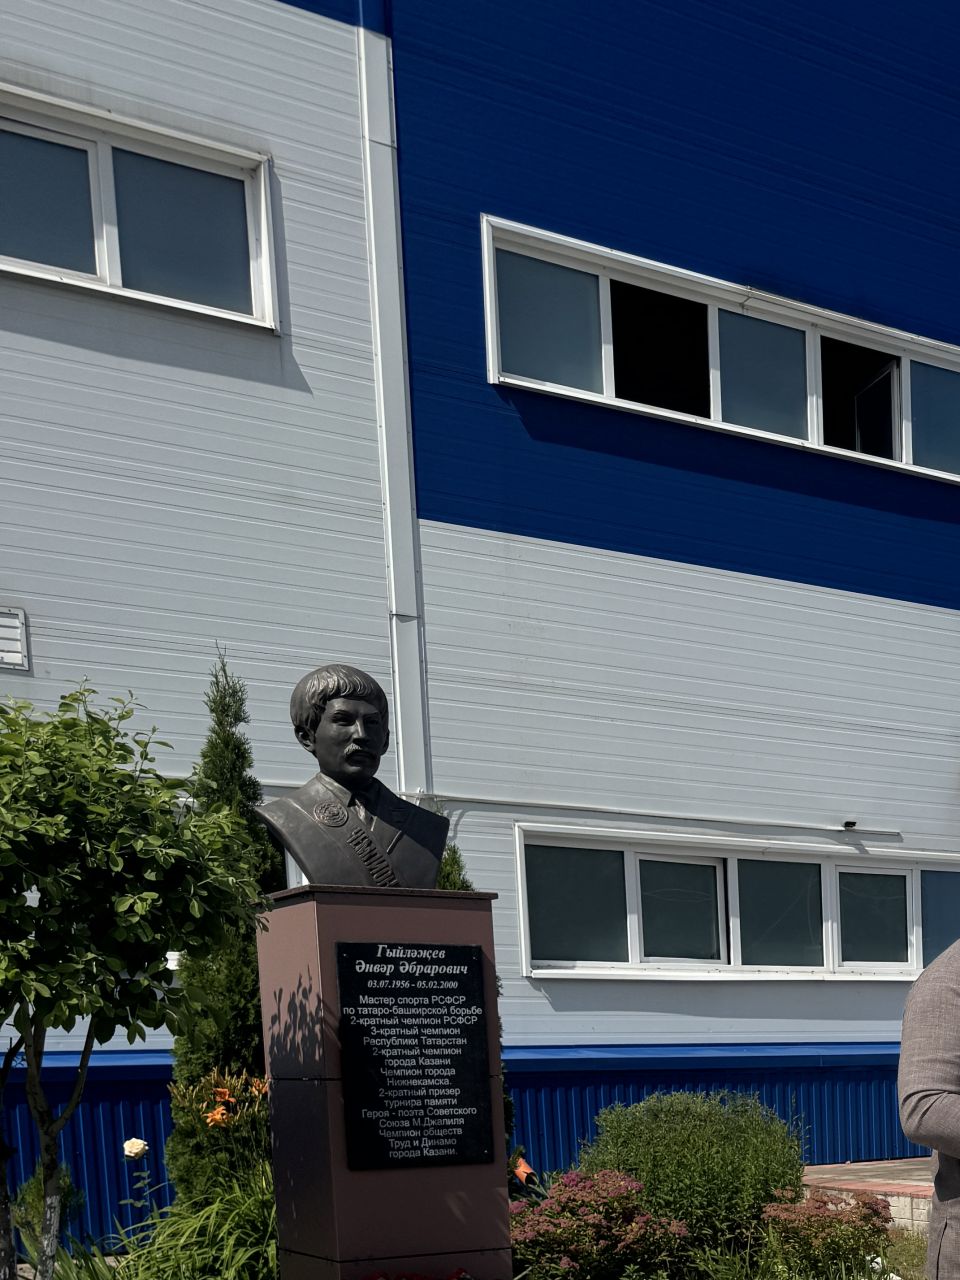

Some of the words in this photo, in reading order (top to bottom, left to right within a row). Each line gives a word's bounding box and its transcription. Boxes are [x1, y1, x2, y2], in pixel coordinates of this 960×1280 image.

[356, 960, 395, 975] Әнвәр
[400, 961, 468, 976] Әбрарович
[368, 980, 410, 988] 03.07.1956
[417, 981, 458, 989] 05.02.2000
[360, 995, 395, 1005] Мастер
[398, 997, 429, 1005] спорта
[432, 996, 466, 1004] РСФСР
[358, 1005, 447, 1016] татаро-башкирской
[450, 1006, 482, 1016] борьбе
[350, 1016, 398, 1026] 2-кратный
[402, 1018, 441, 1026] чемпион
[444, 1016, 478, 1024] РСФСР
[371, 1026, 418, 1036] 3-кратный
[421, 1028, 460, 1036] чемпион
[364, 1036, 418, 1047] Республики
[421, 1037, 467, 1046] Татарстан
[373, 1046, 420, 1056] 2-кратный
[422, 1048, 462, 1056] чемпион
[385, 1059, 416, 1068] города
[418, 1057, 451, 1065] Казани
[380, 1068, 422, 1077] Чемпион
[425, 1069, 455, 1077] города
[379, 1088, 426, 1098] 2-кратный
[429, 1088, 460, 1096] призер
[384, 1099, 421, 1108] турнира
[425, 1098, 458, 1106] памяти
[362, 1109, 389, 1119] Героя
[398, 1109, 424, 1117] поэта
[427, 1107, 477, 1115] Советского
[380, 1119, 410, 1128] Союза
[379, 1129, 421, 1138] Чемпион
[423, 1128, 462, 1137] обществ
[389, 1139, 411, 1148] Труд
[421, 1138, 456, 1147] Динамо
[389, 1150, 421, 1159] города
